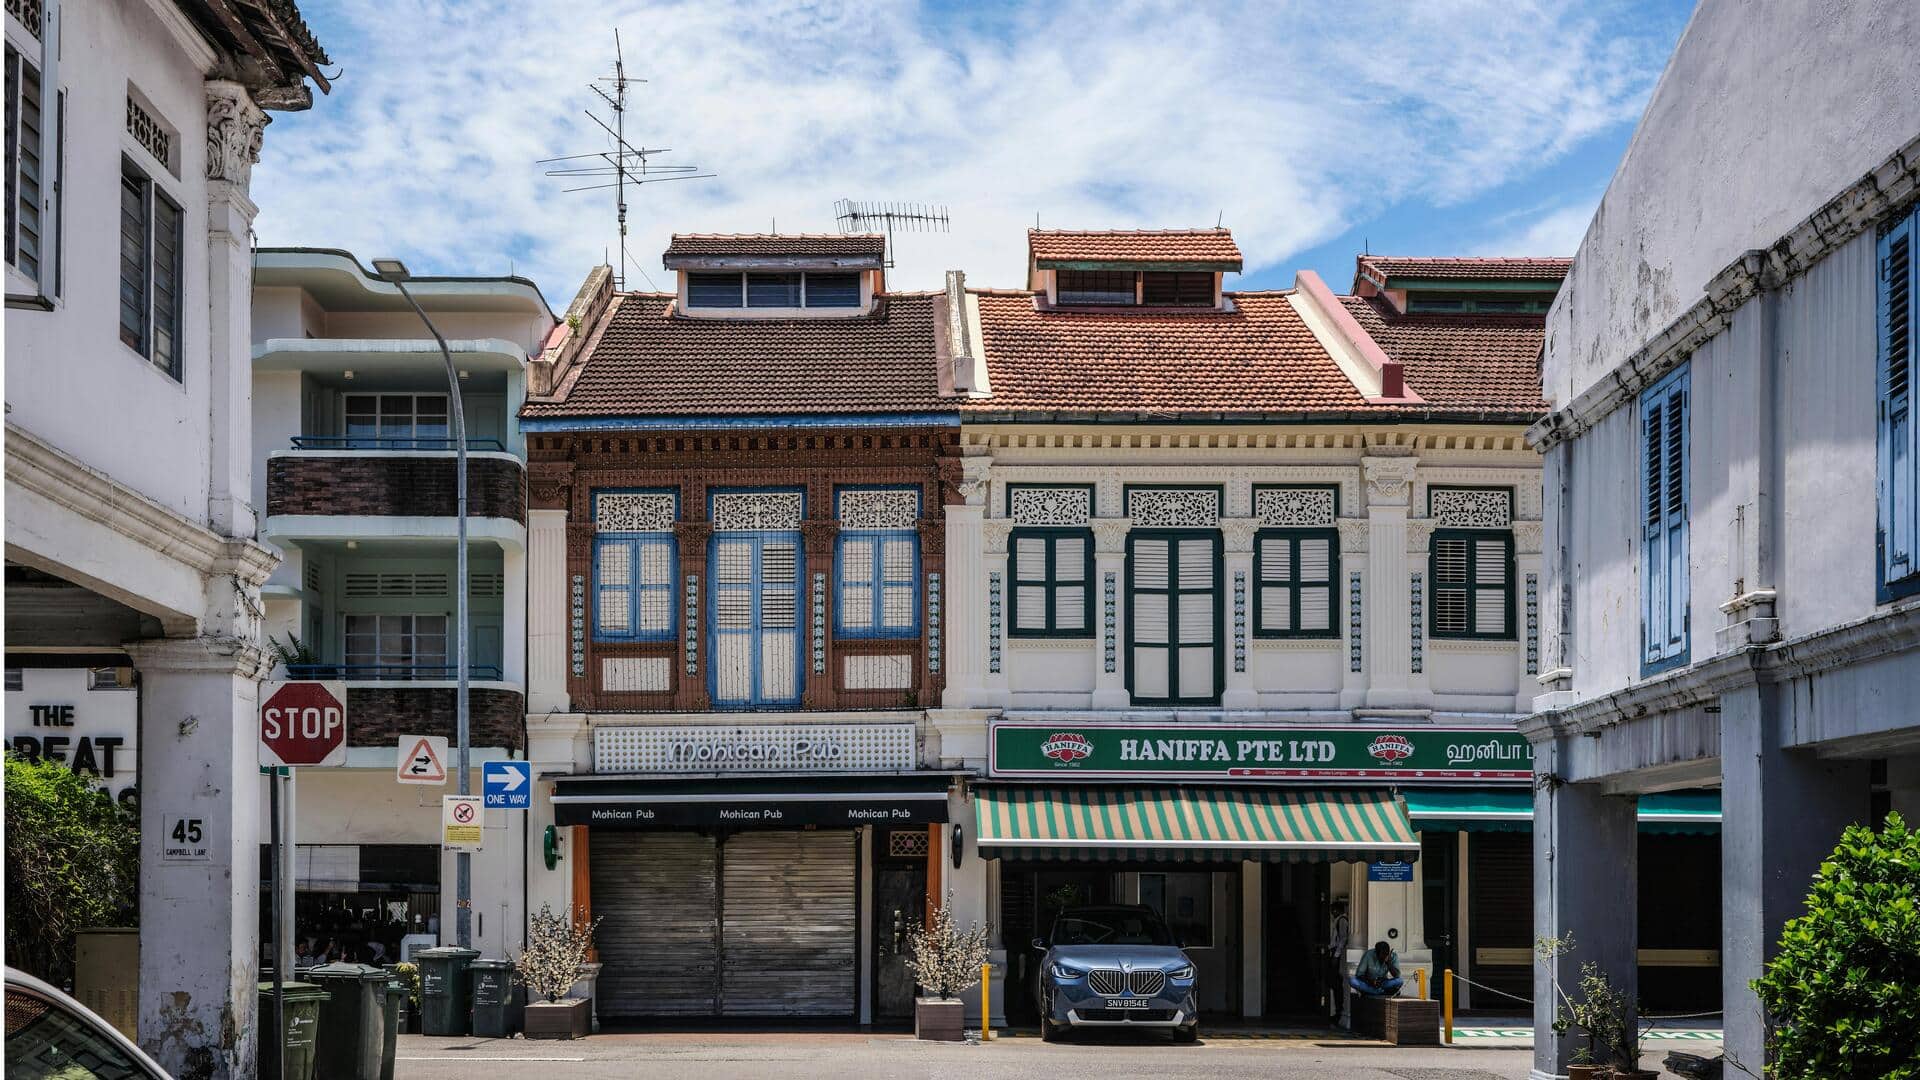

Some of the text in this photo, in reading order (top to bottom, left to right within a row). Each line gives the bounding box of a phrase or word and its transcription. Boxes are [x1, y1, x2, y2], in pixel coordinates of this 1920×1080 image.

[29, 705, 74, 726] THE
[265, 707, 341, 739] STOP
[5, 736, 123, 777] REAT
[669, 738, 841, 762] Mohican Pub
[1044, 741, 1089, 752] HANIFFA
[1119, 739, 1336, 762] HANIFFA PTE LTD
[1372, 743, 1411, 753] HANIFFA
[1446, 740, 1522, 765] ஹனிபா
[487, 794, 527, 804] ONE WAY
[592, 810, 655, 819] Mohican Pub
[720, 810, 783, 819] Mohican Pub
[848, 809, 911, 818] Mohican Pub
[172, 819, 203, 843] 45
